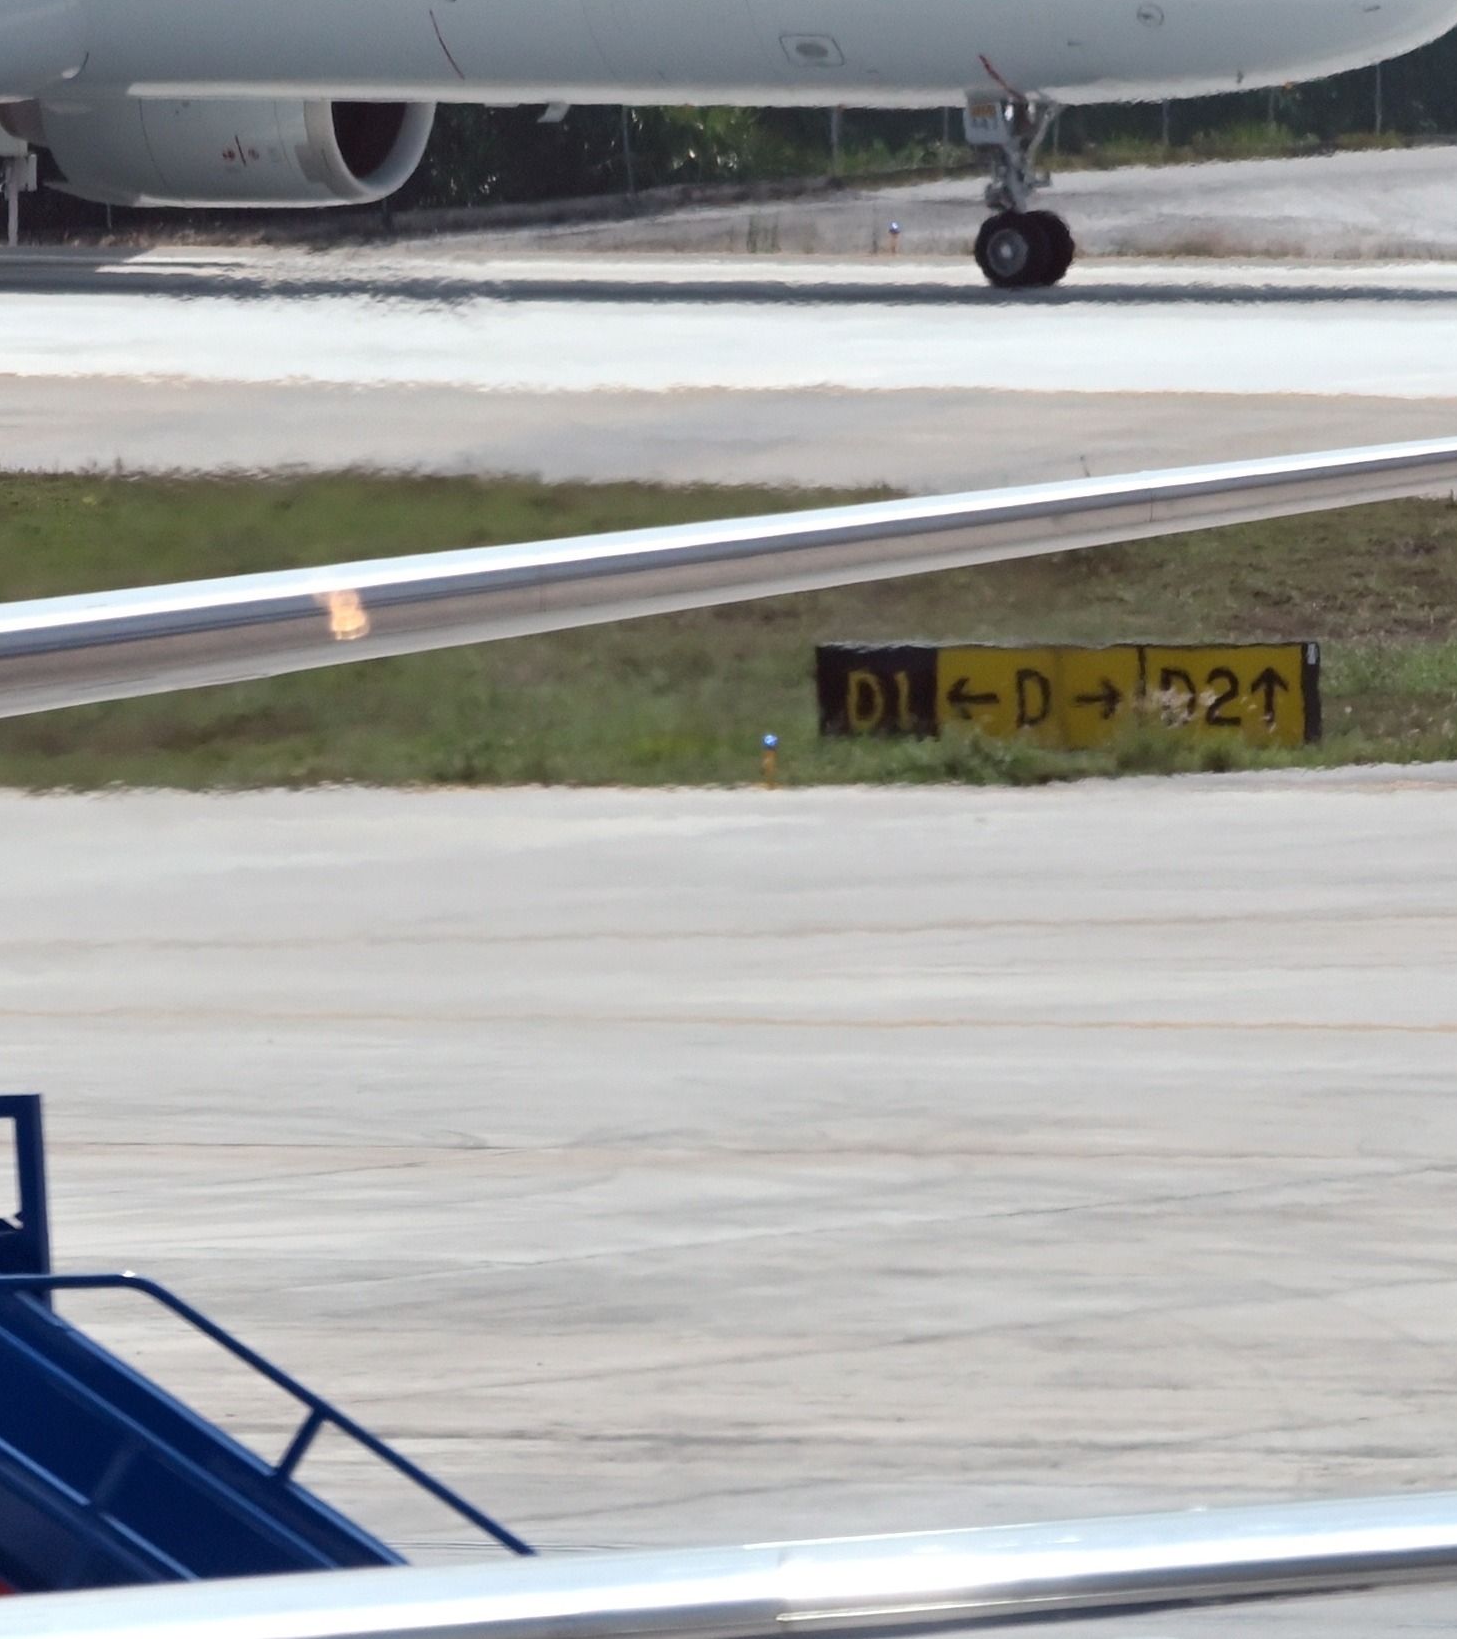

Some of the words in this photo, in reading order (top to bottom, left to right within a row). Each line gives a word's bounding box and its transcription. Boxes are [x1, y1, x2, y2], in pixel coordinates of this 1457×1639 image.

[847, 668, 911, 732] D1
[1017, 668, 1052, 728] D
[1160, 667, 1242, 726] D2
